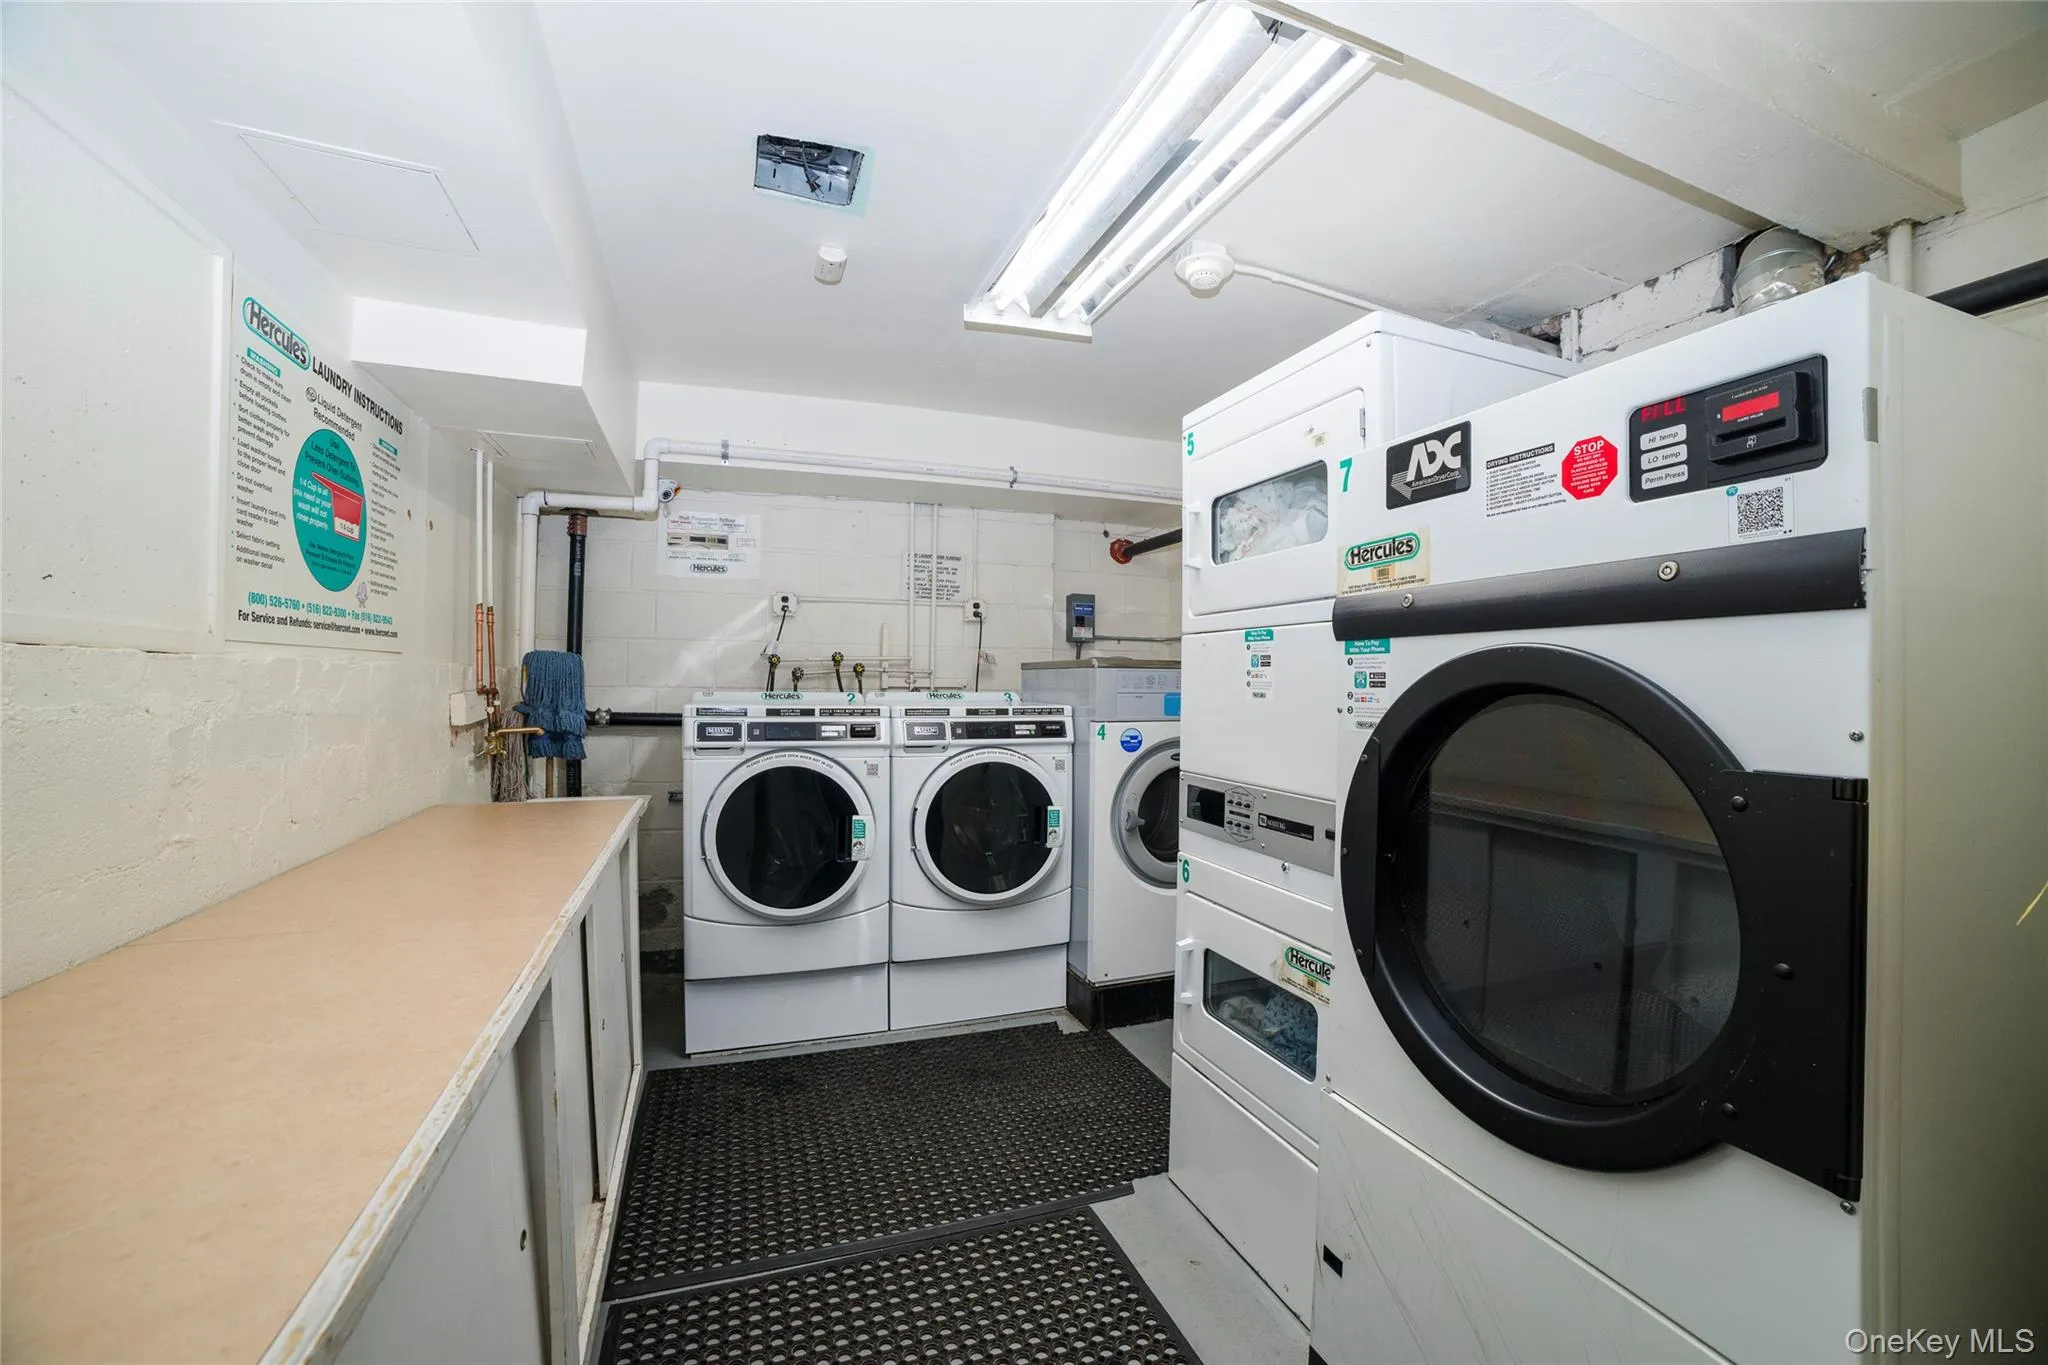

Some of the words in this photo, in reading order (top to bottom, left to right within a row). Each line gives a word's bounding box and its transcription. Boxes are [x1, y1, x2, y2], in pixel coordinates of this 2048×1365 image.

[248, 302, 306, 364] Hercules
[240, 380, 254, 395] Empty
[313, 356, 352, 398] LAUNDRY
[353, 388, 403, 435] INSTRUCTIONS
[239, 390, 254, 405] before
[255, 400, 271, 415] loading
[317, 394, 335, 413] Liquid
[337, 407, 362, 432] Detergent
[238, 438, 249, 450] Load
[1187, 432, 1195, 456] 5
[1659, 431, 1679, 442] temp
[1406, 430, 1462, 481] ADC
[1573, 440, 1605, 456] STOP
[1487, 458, 1508, 468] DRYING
[1508, 445, 1554, 462] INSTRUCTIONS
[1647, 456, 1658, 464] LO
[1662, 451, 1681, 461] temp
[237, 460, 249, 470] close
[251, 465, 261, 474] door
[1339, 457, 1353, 493] 7
[237, 472, 244, 480] Do
[1645, 475, 1664, 485] Perm
[1664, 471, 1686, 480] Press
[307, 480, 316, 492] Cup
[236, 530, 251, 541] Select
[236, 544, 259, 557] Additional
[1350, 537, 1413, 565] Hercules
[693, 563, 726, 573] Hercules
[248, 591, 268, 608] (800)
[352, 609, 360, 620] Fax
[238, 609, 249, 621] For
[251, 612, 276, 625] Service
[276, 614, 288, 626] and
[289, 616, 313, 628] Refunds:
[764, 692, 800, 700] Hercules
[847, 692, 856, 705] 2
[1003, 692, 1013, 706] 3
[1097, 724, 1106, 740] 4
[1182, 859, 1190, 883] 6
